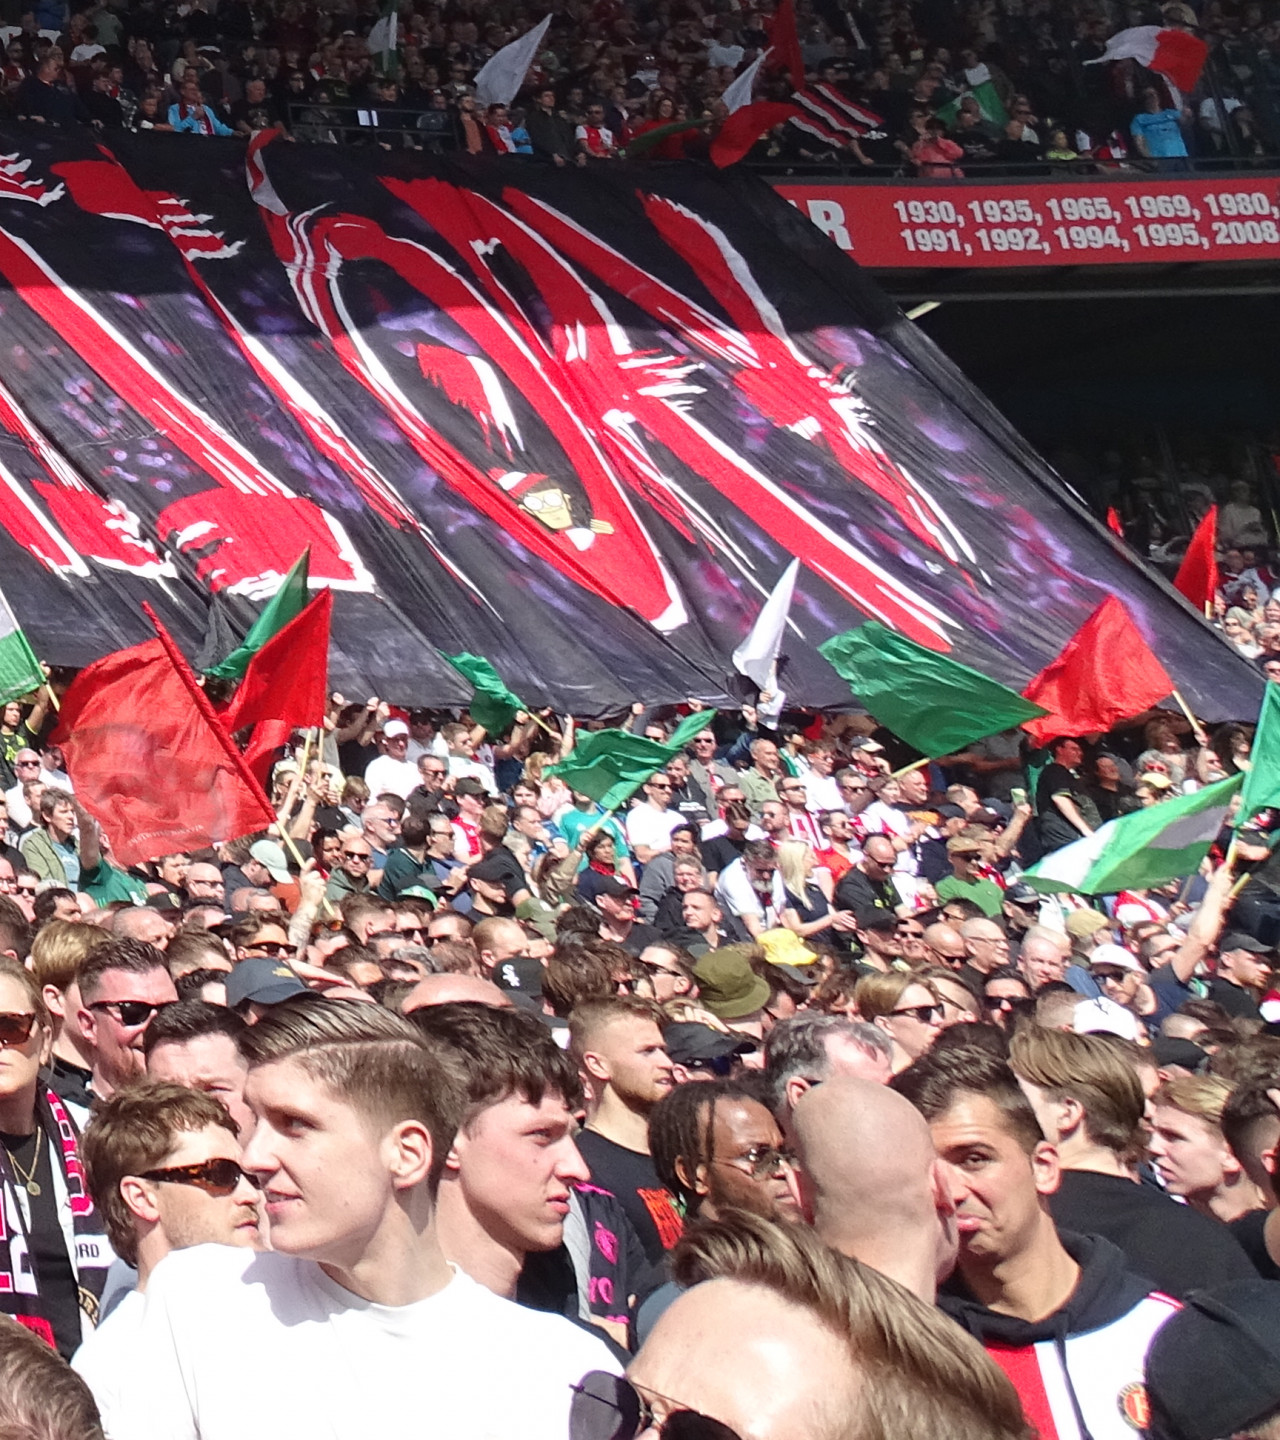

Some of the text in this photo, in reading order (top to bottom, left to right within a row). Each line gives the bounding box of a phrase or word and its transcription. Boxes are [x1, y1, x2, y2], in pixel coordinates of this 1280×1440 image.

[894, 192, 1279, 228] 1930, 1935, 1965, 1969, 1980,
[901, 227, 973, 256] 1991,
[976, 226, 1051, 254] 1992,
[1055, 224, 1129, 252] 1994,
[1139, 222, 1209, 250] 1995,
